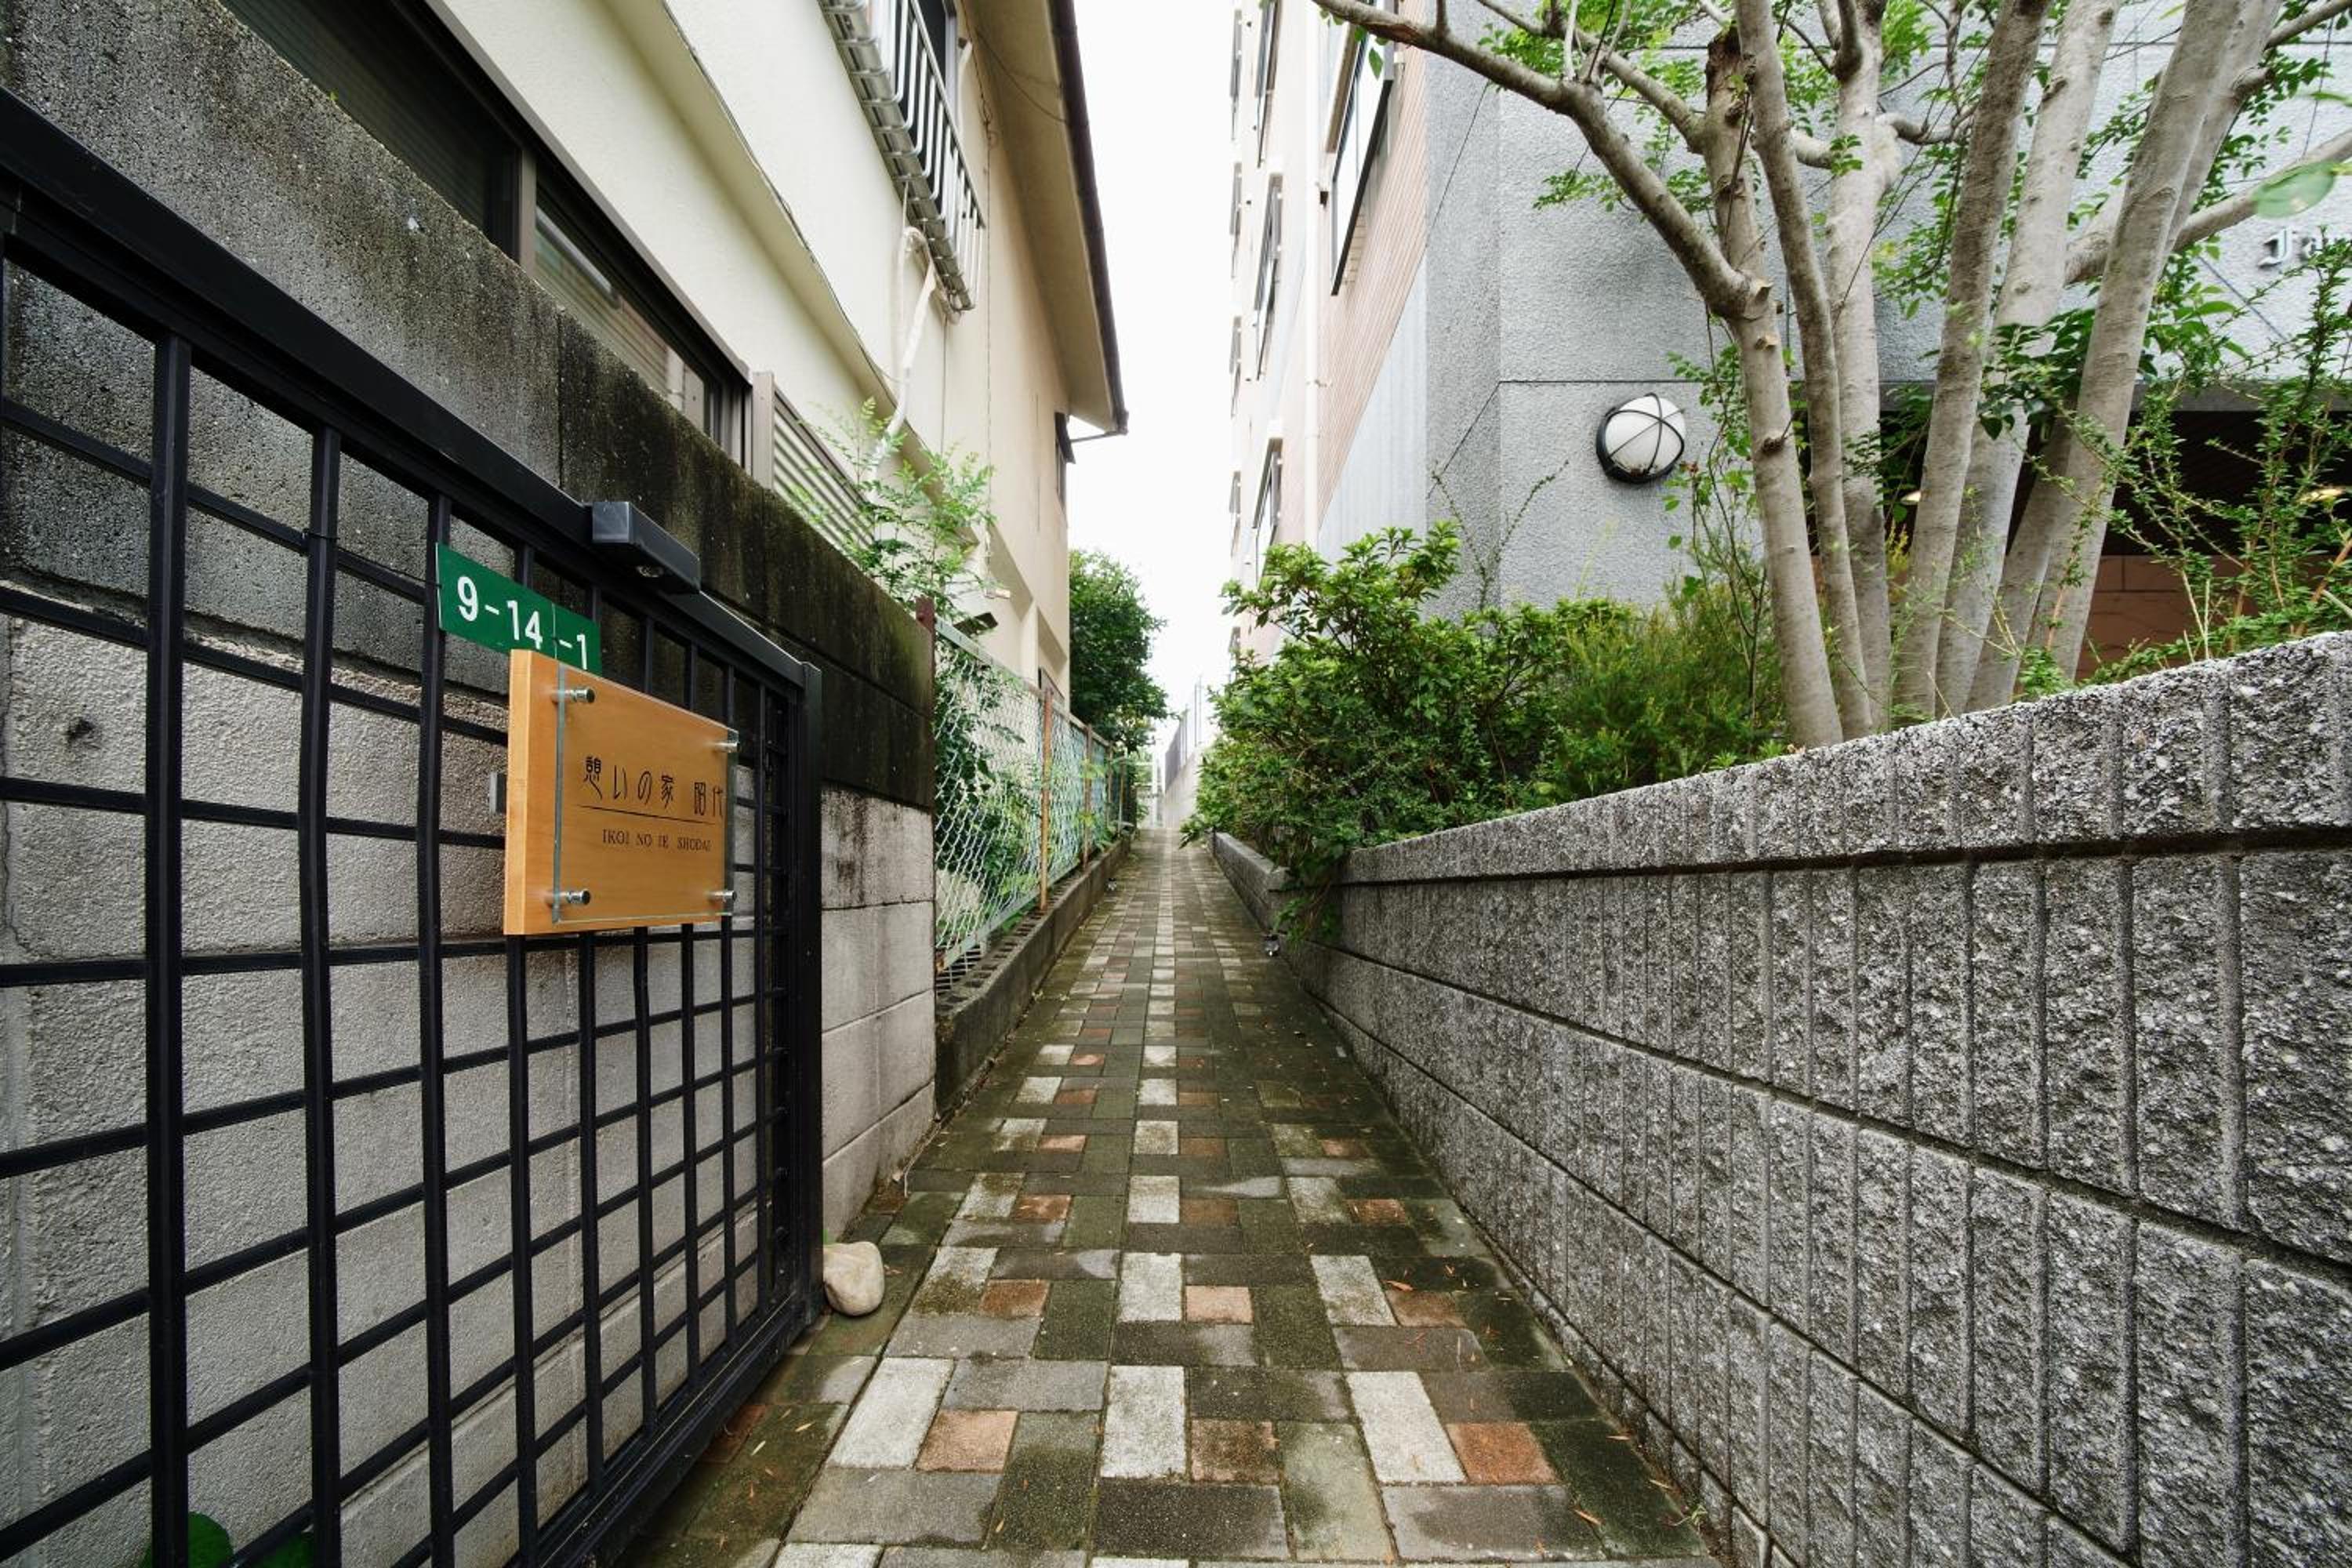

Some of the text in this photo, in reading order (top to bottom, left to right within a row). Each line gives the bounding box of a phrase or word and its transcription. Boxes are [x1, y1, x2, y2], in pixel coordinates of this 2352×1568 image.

[602, 829, 630, 845] IKOI
[637, 833, 653, 848] NO
[659, 834, 670, 849] IE
